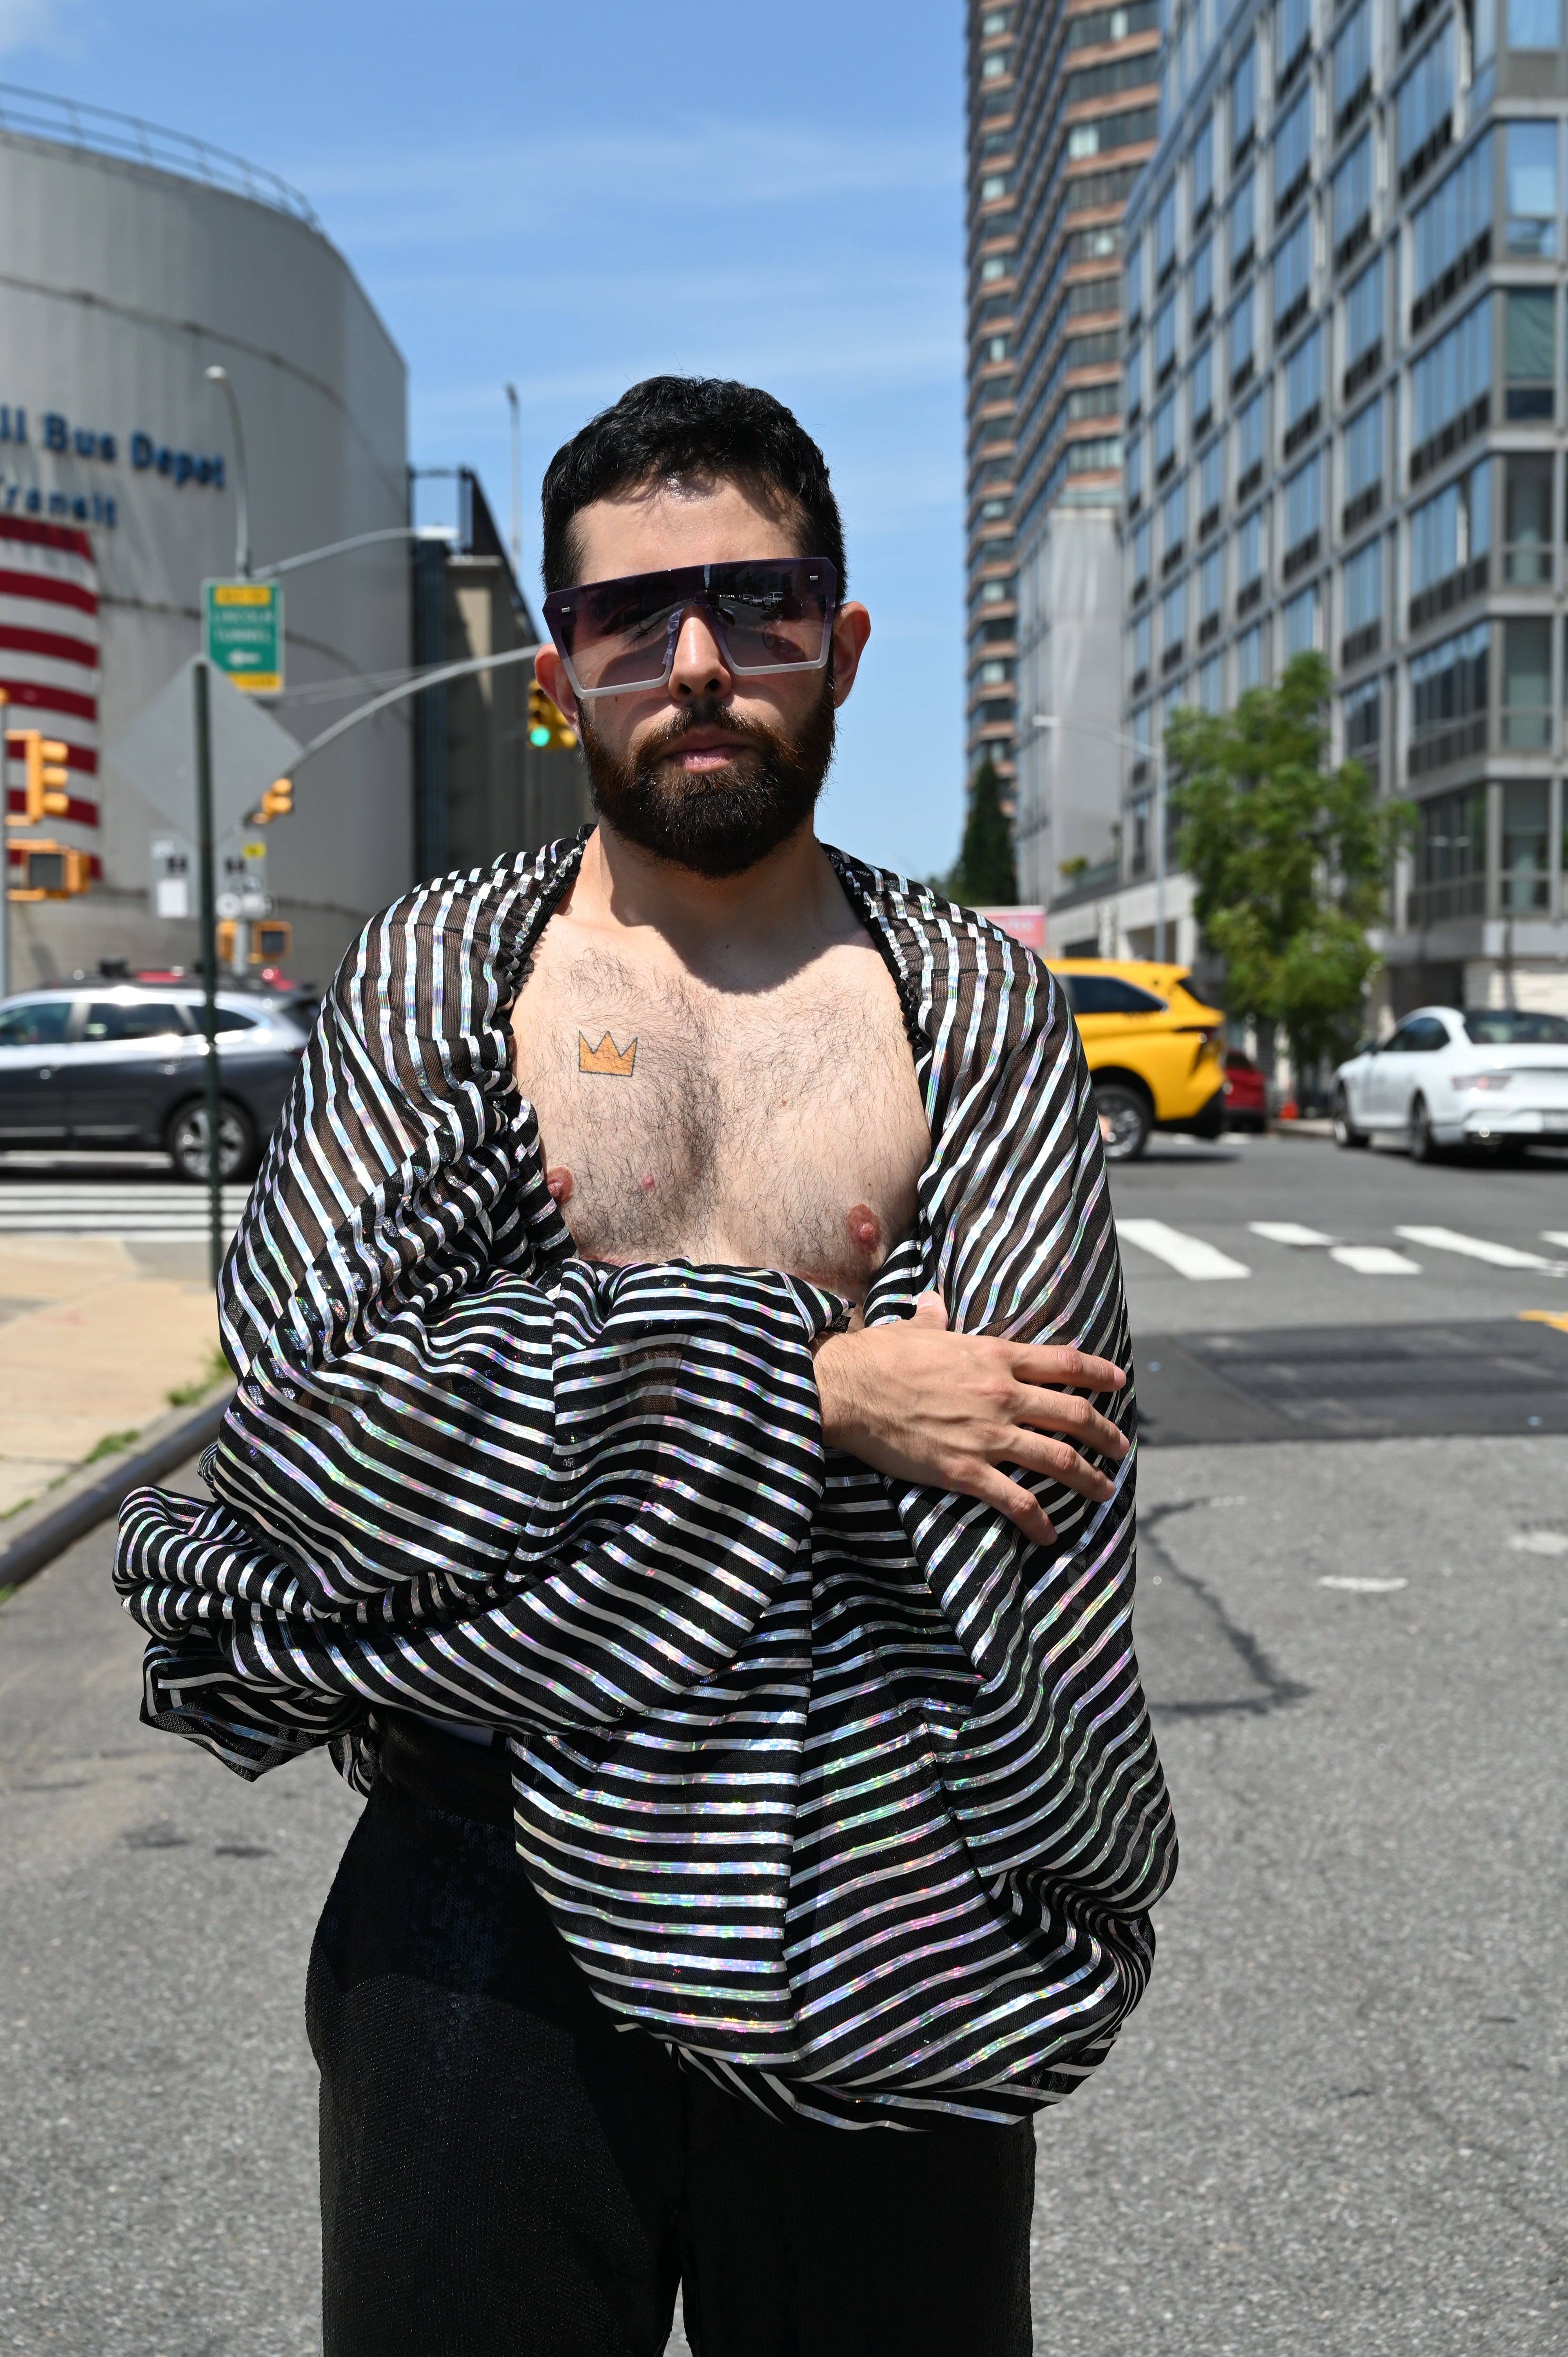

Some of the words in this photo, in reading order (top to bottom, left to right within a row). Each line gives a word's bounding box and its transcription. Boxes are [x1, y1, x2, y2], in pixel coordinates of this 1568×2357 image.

[44, 412, 116, 462] Bus
[131, 432, 224, 488] Depot
[0, 476, 116, 528] ransit
